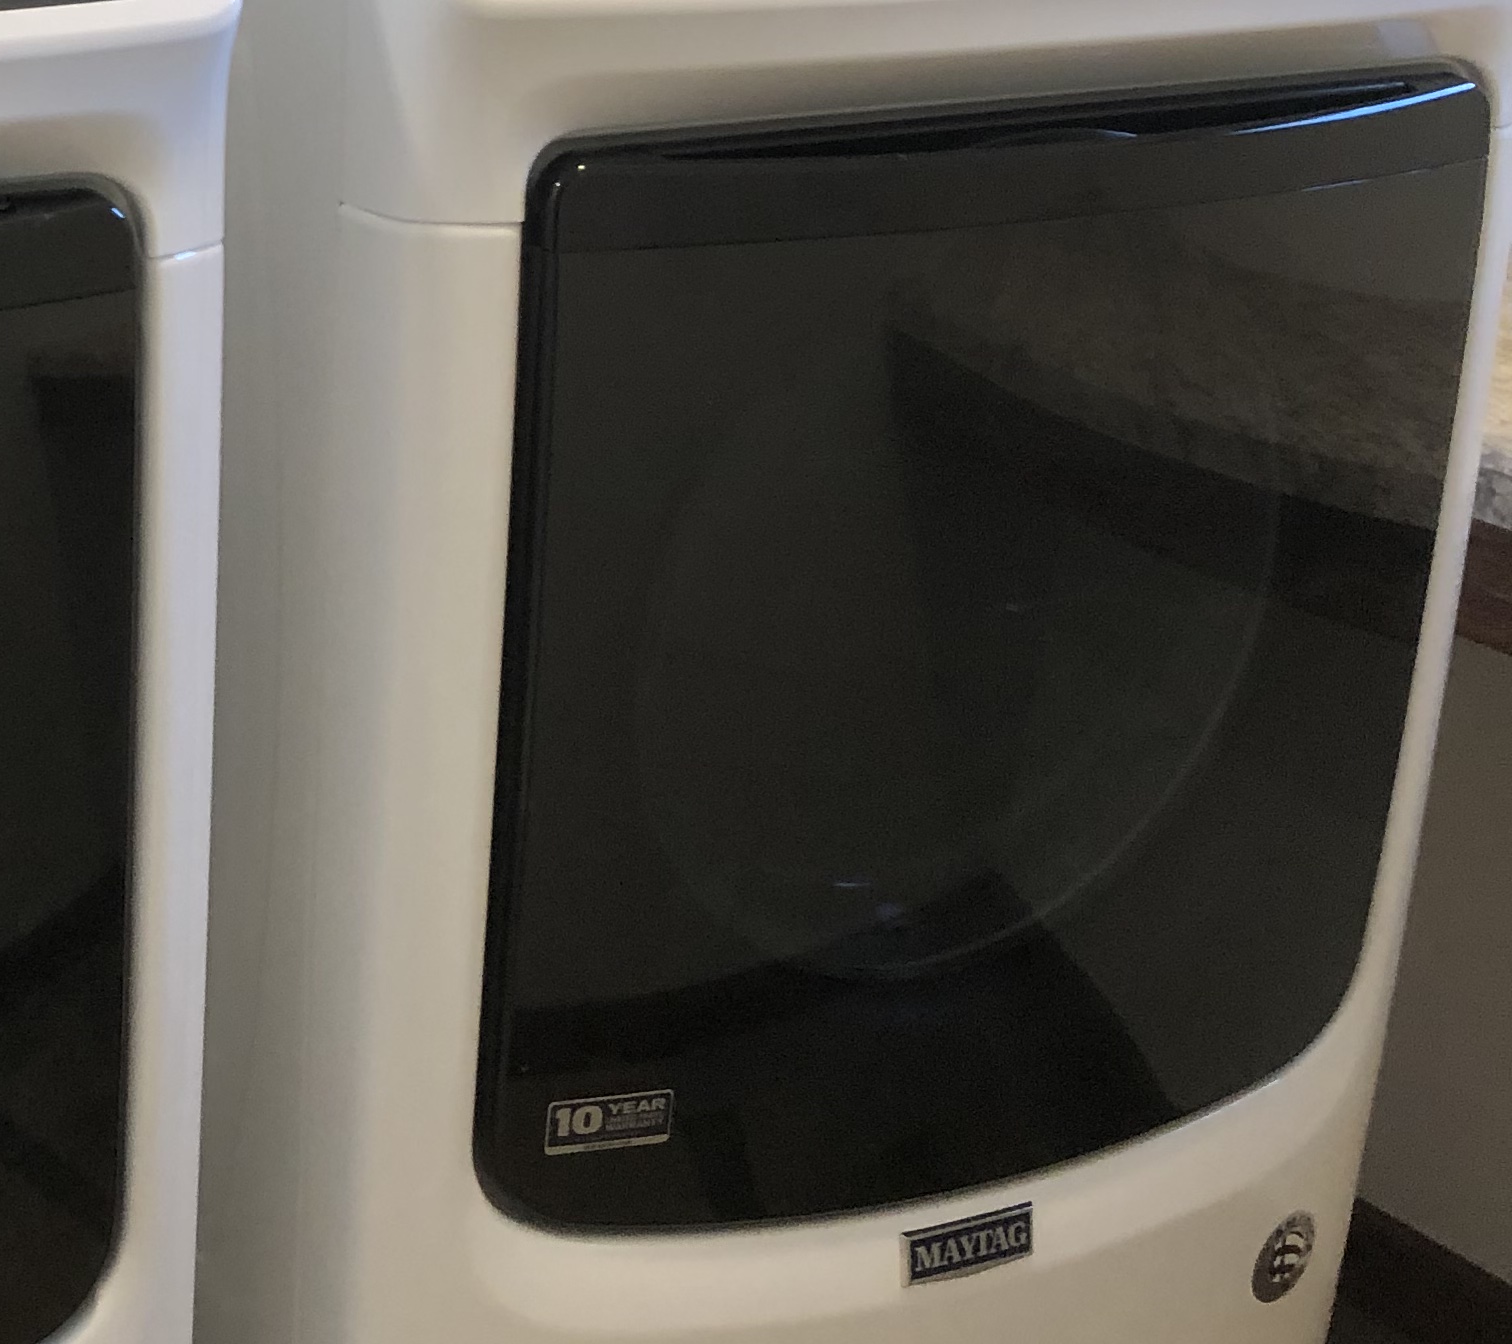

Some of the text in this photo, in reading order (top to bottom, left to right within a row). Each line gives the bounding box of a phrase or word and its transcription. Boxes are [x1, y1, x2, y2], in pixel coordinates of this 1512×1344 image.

[555, 1105, 603, 1137] 10
[608, 1098, 667, 1115] YEAR
[915, 1221, 1028, 1271] MAYTAG
